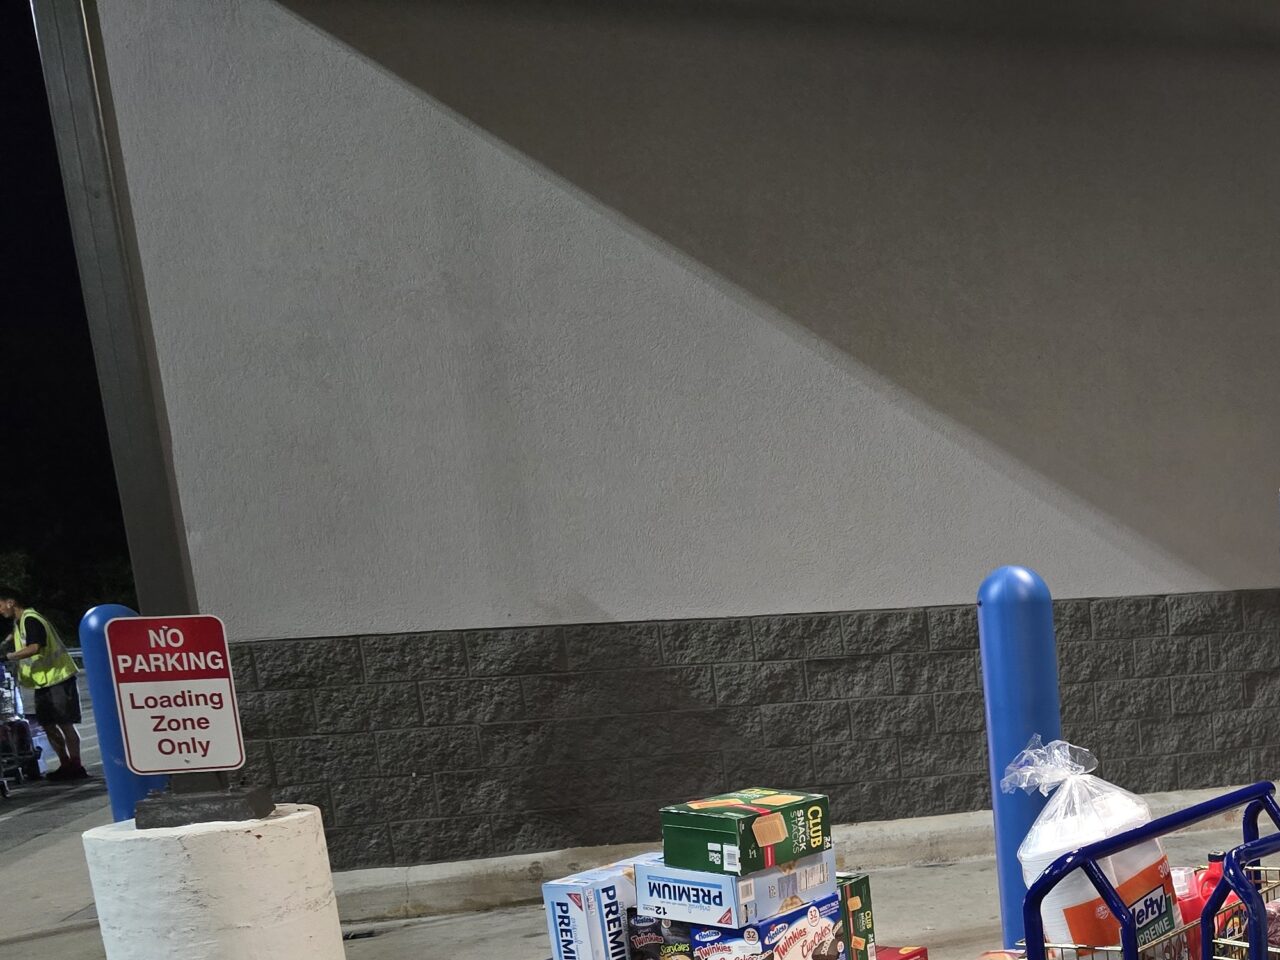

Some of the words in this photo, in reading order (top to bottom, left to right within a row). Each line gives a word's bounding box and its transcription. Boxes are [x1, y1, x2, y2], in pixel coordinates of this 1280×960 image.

[148, 628, 184, 648] NO
[116, 651, 224, 673] PARKING
[129, 690, 224, 709] Loading
[150, 715, 210, 732] Zone
[158, 737, 210, 757] Only
[790, 810, 800, 854] STACKS
[797, 809, 807, 852] SNACK
[807, 805, 823, 848] CLUB
[648, 881, 723, 907] PREMIUM
[655, 905, 667, 915] 12
[809, 910, 817, 920] 32
[698, 930, 720, 940] Hostess
[767, 924, 787, 944] Hostess
[801, 924, 830, 959] CupCakes
[1138, 917, 1170, 946] PREME
[695, 943, 732, 960] Twinkies
[774, 927, 807, 960] Twinkies
